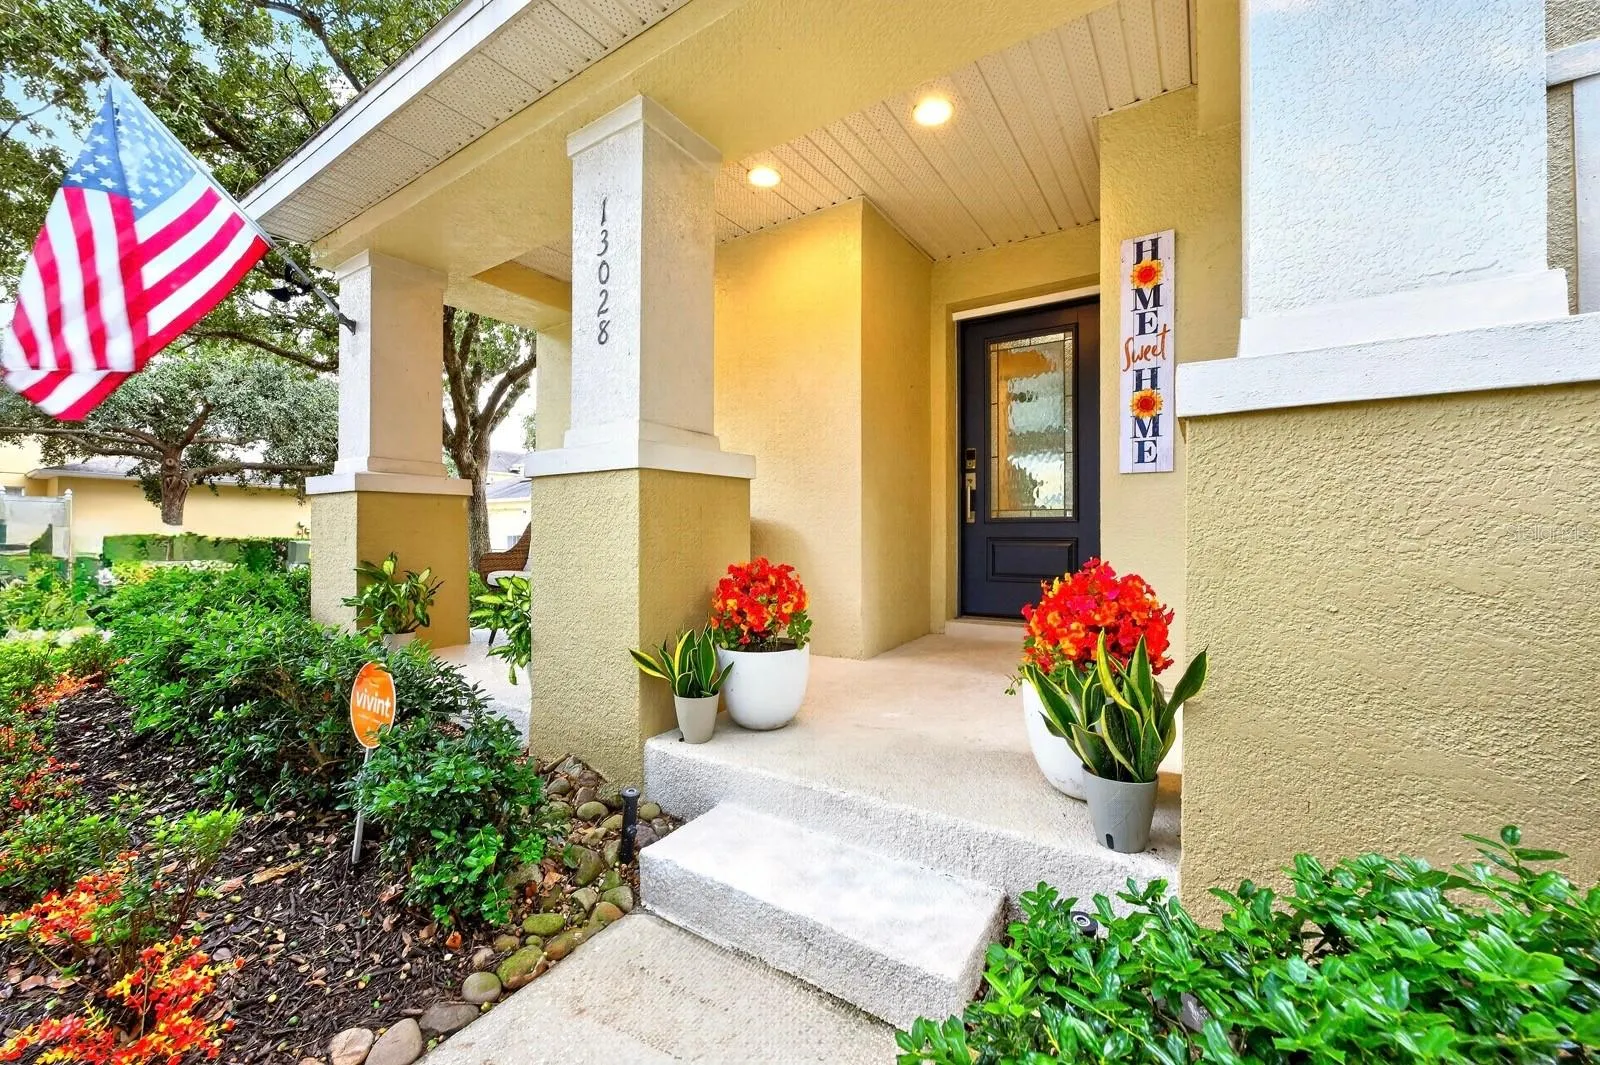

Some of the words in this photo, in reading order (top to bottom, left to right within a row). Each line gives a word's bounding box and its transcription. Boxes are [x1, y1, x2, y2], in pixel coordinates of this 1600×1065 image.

[596, 196, 611, 345] 13028
[1122, 323, 1171, 373] Sweet
[356, 688, 391, 718] vivint
